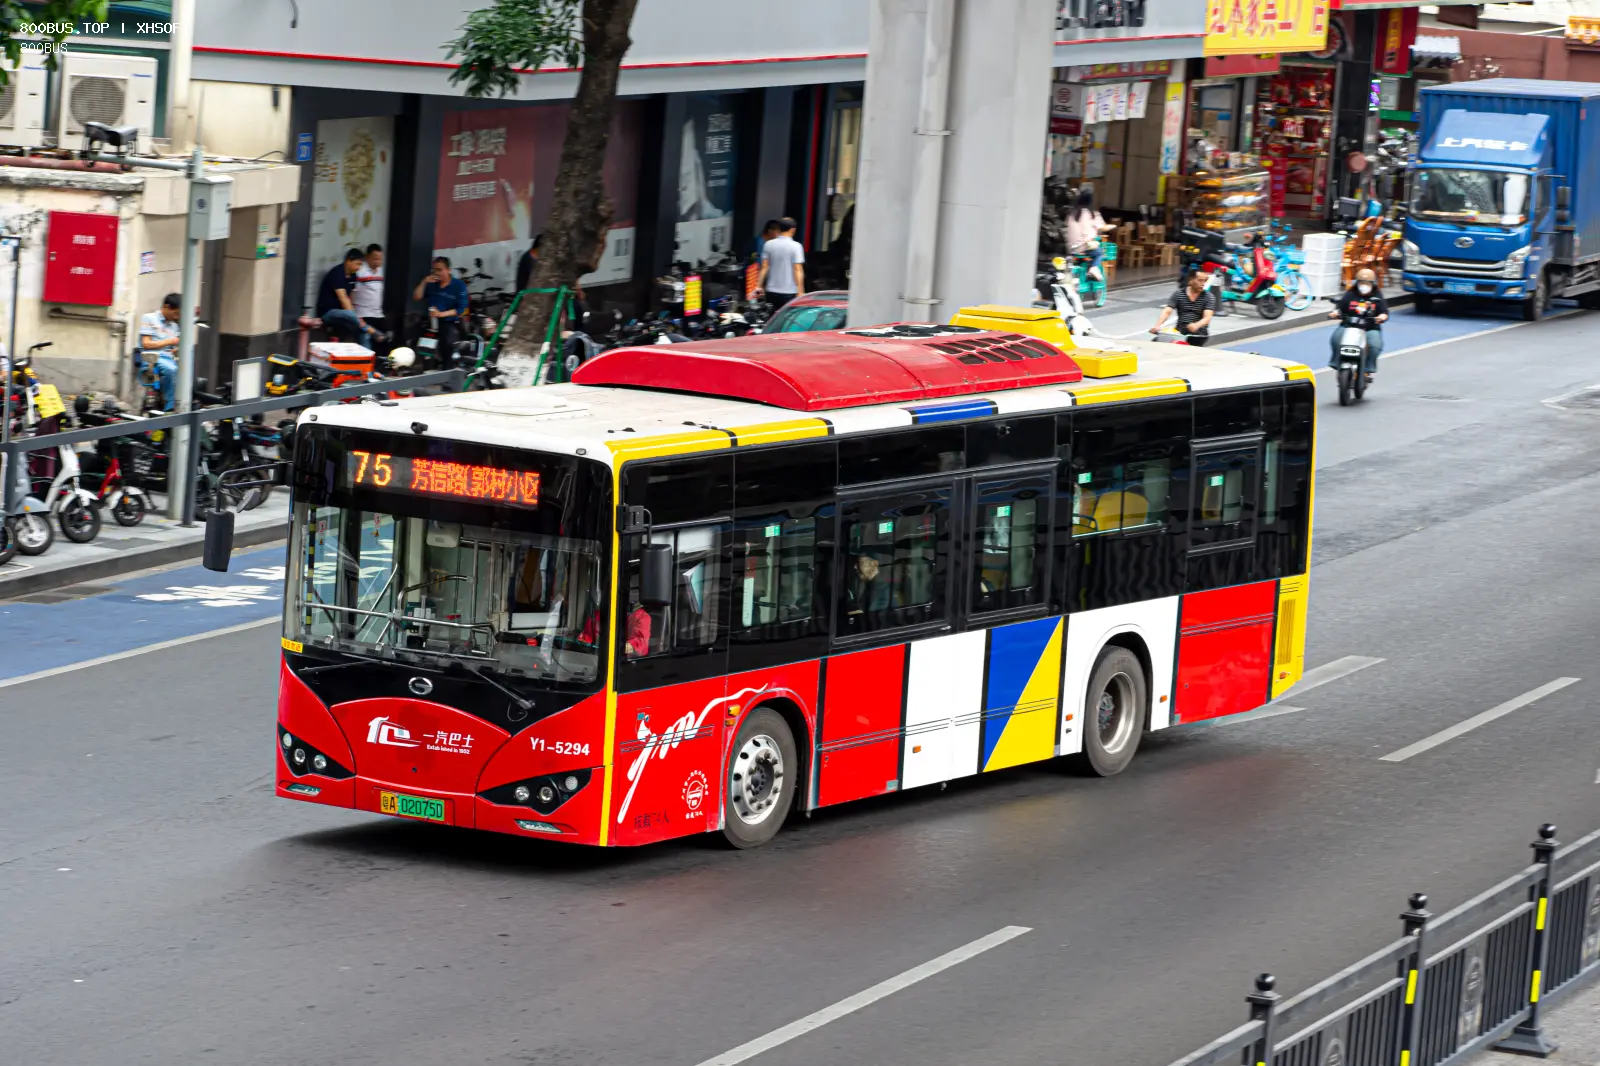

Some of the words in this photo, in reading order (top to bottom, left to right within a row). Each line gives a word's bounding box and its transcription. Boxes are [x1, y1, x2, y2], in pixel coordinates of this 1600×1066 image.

[352, 450, 393, 486] 75
[422, 730, 475, 749] 一汽巴士
[529, 736, 591, 756] Y1-5294
